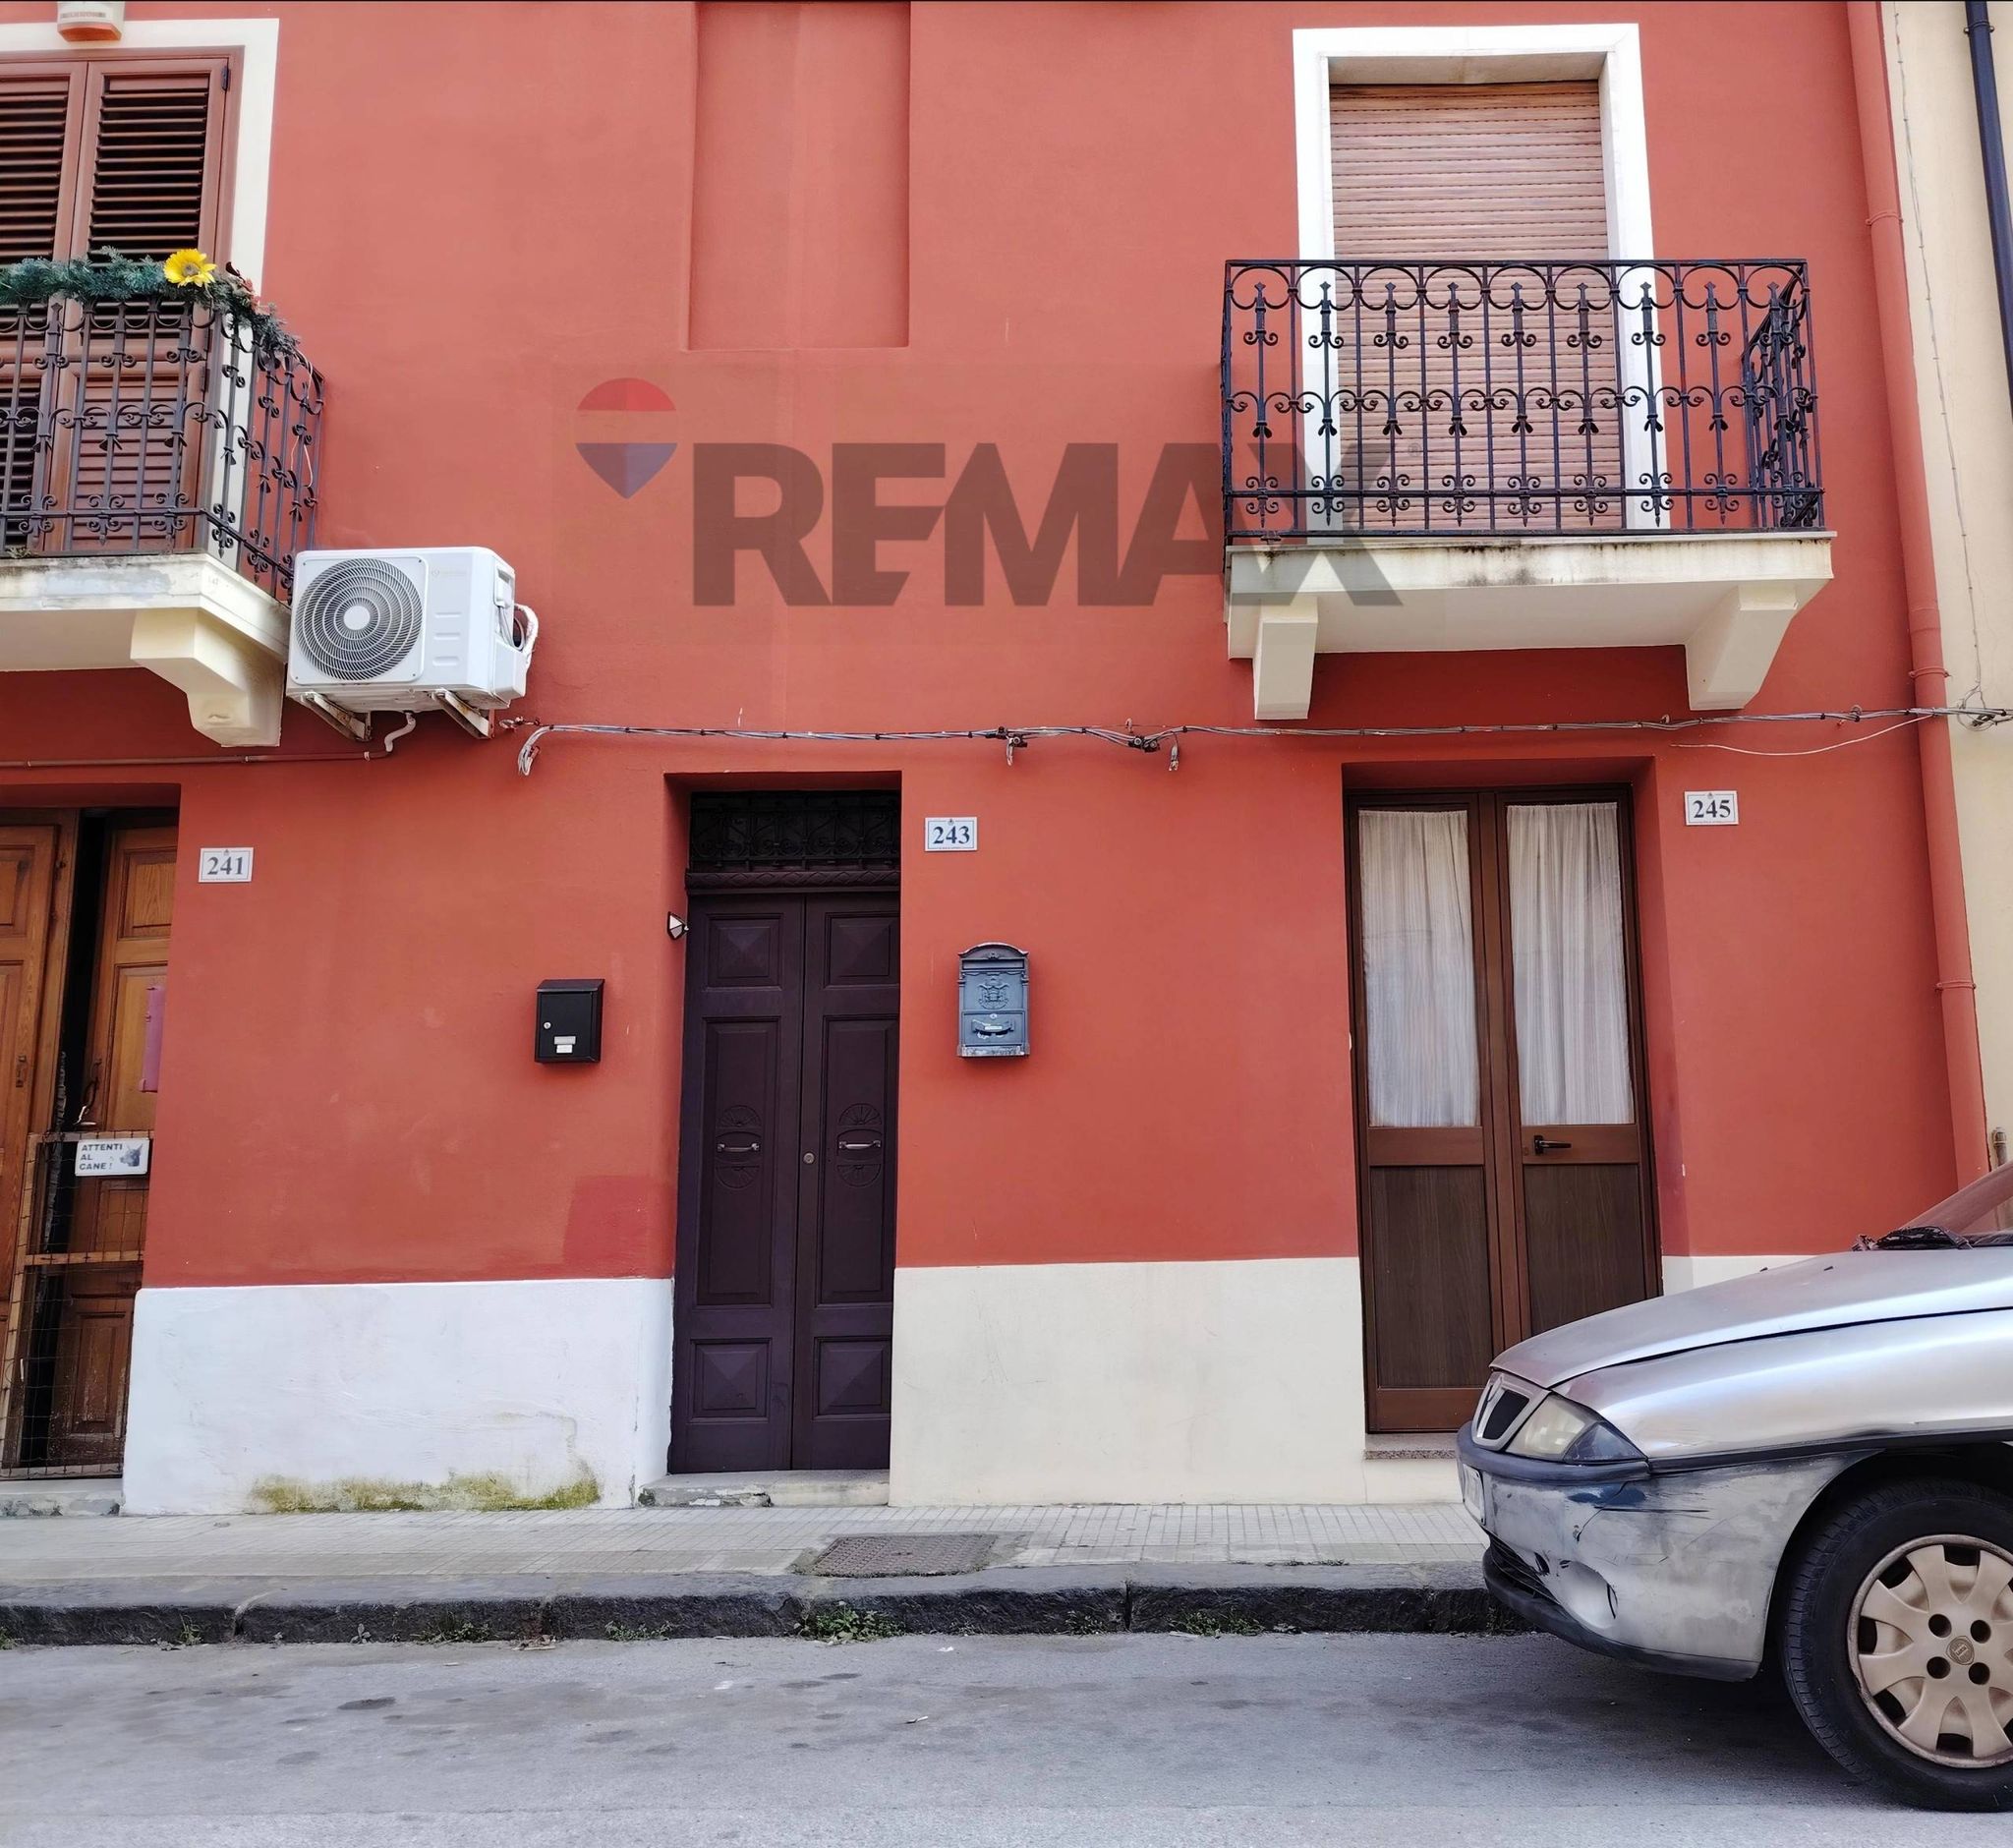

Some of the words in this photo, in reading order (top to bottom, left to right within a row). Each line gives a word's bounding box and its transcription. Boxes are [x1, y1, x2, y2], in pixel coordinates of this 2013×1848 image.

[1693, 799, 1731, 818] 245
[933, 826, 970, 844] 243
[206, 856, 243, 875] 241
